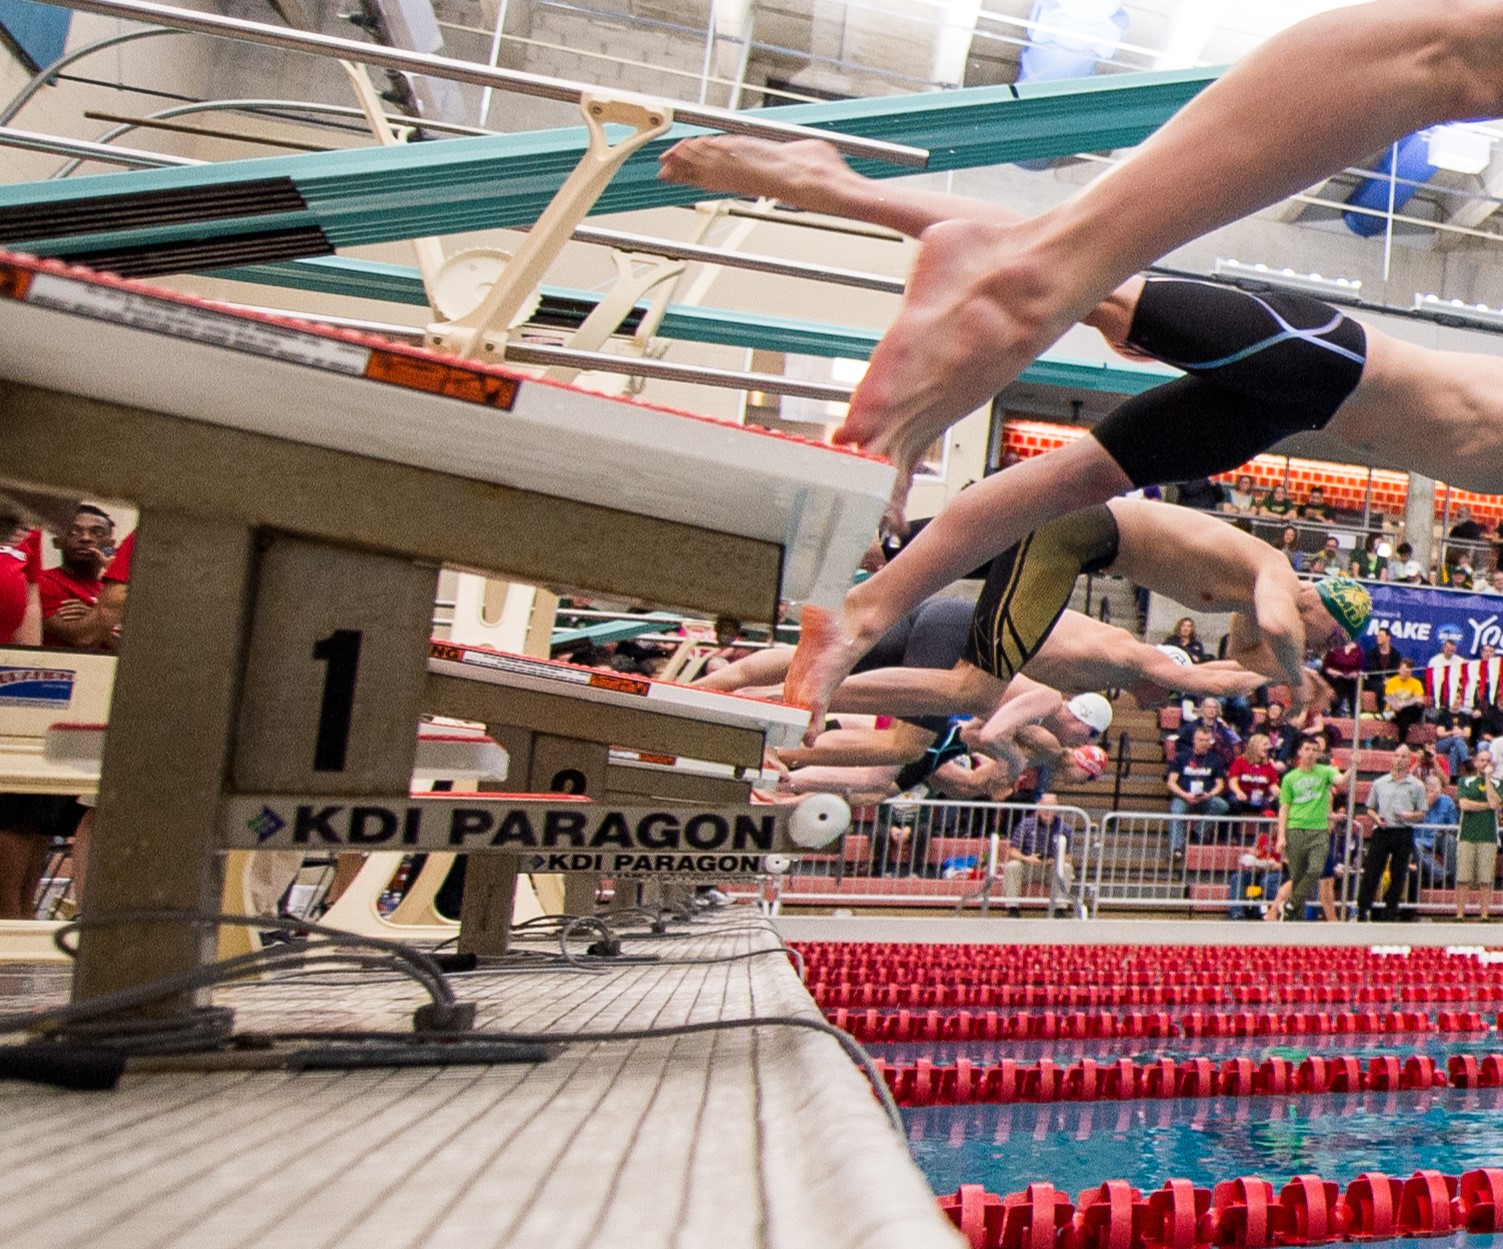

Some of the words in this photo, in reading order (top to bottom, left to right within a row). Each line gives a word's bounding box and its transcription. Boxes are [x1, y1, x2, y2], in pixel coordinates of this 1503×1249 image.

[1366, 618, 1432, 642] MAKE
[312, 628, 363, 773] 1
[292, 804, 422, 845] KDI
[449, 808, 776, 850] PARAGON
[549, 854, 601, 871] KDI
[613, 855, 760, 873] PARAGON
